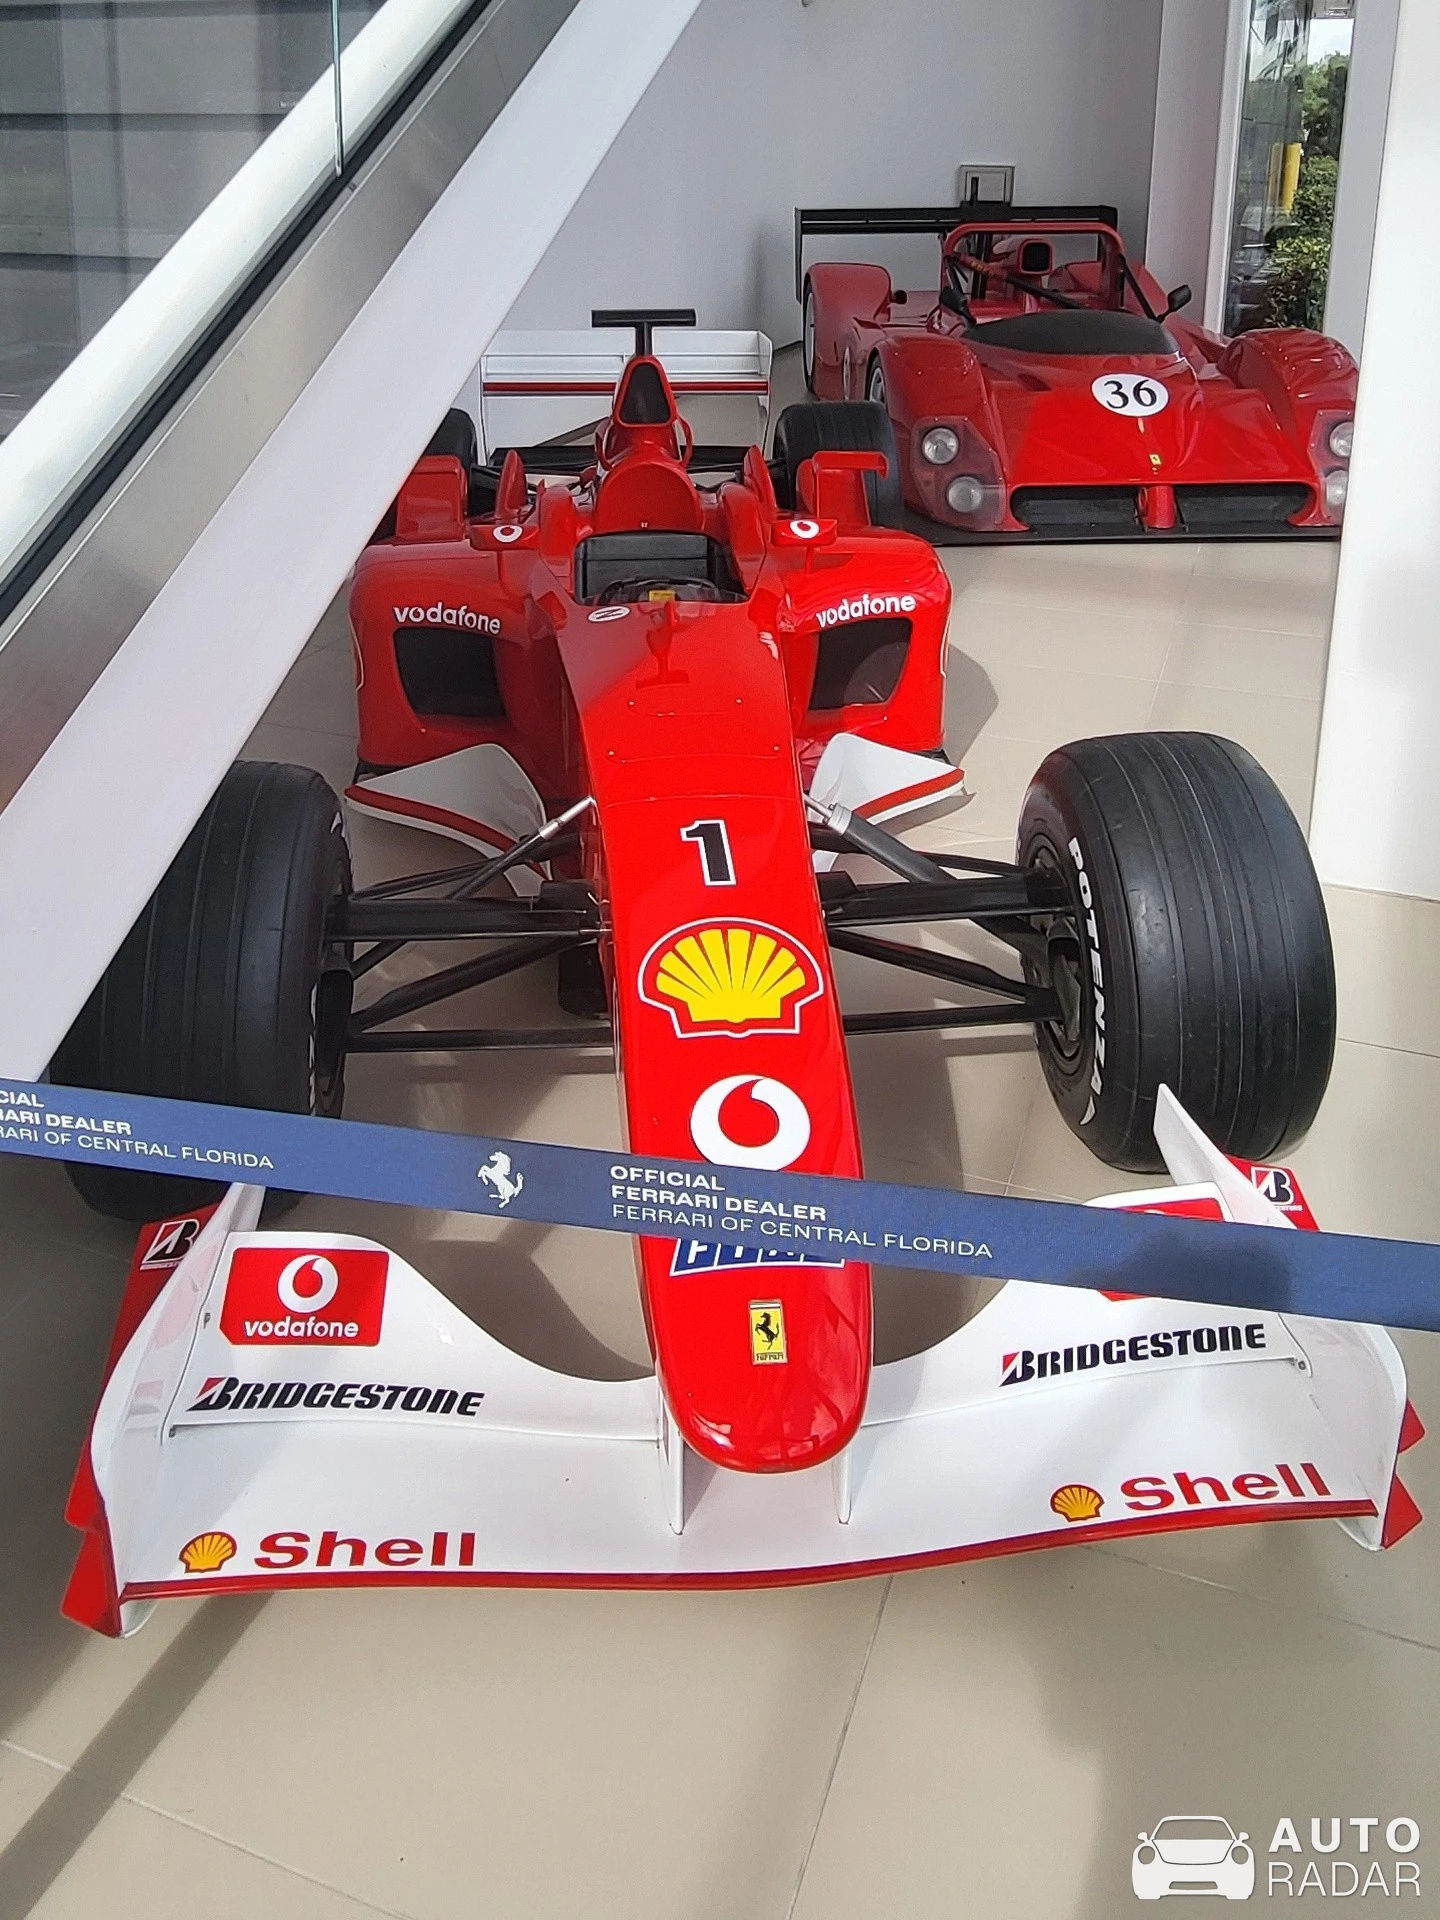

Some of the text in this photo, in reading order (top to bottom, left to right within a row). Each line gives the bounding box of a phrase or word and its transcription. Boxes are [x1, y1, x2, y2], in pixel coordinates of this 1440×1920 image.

[1104, 379, 1157, 409] 36
[394, 602, 502, 636] vodafone
[816, 593, 917, 627] vodafone
[681, 819, 737, 886] 1
[45, 1113, 131, 1135] DEALER
[44, 1131, 72, 1145] OF
[78, 1135, 177, 1158] CENTRAL
[181, 1146, 274, 1169] FLORIDA
[610, 1165, 726, 1191] OFFICIAL
[611, 1185, 826, 1222] FERRARI DEALER
[612, 1204, 993, 1259] FERRARI OF CENTRAL FLORIDA
[244, 1316, 359, 1339] vodafone
[999, 1322, 1267, 1388] BRIDGESTONE
[186, 1377, 485, 1417] BRIDGESTONE
[1119, 1462, 1332, 1512] Shell
[254, 1531, 476, 1567] Shell
